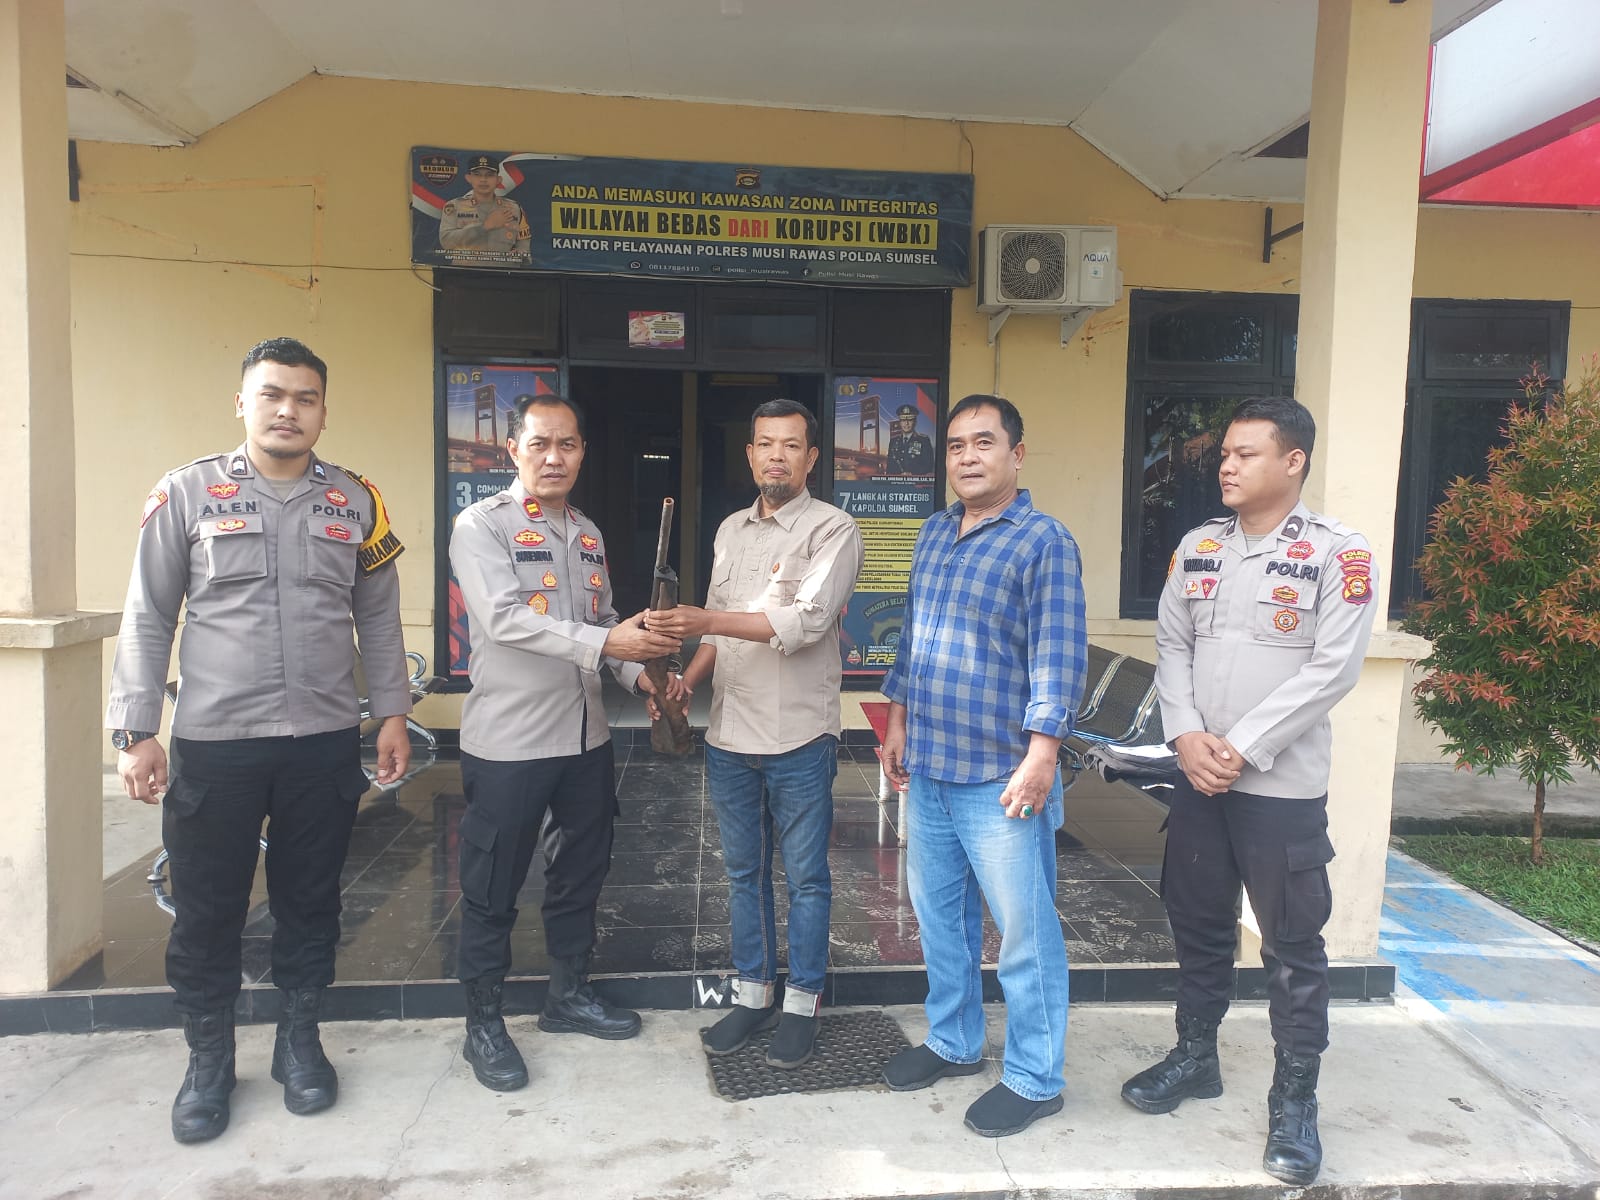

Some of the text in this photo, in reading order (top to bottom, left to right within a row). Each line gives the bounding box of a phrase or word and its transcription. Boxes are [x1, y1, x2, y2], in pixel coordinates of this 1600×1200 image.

[551, 185, 938, 215] ANDA MEMASUKI KAWASAN ZONA INTEGRITAS
[560, 207, 649, 233] WILAYAH
[657, 212, 721, 237] BEBAS
[728, 218, 769, 239] DARI
[775, 217, 861, 242] KORUPSI
[552, 238, 938, 265] KANTOR PELAYANAN POLRES MUSI RAWAS POLDA SUMSEL
[1083, 253, 1109, 262] AQUA
[456, 481, 472, 508] 3
[839, 492, 851, 512] 7
[852, 493, 930, 502] LANGKAH STRATEGIS
[202, 501, 257, 515] ALEN
[312, 504, 361, 521] POLRI
[852, 504, 919, 513] KAPOLDA SUMSEL
[580, 552, 604, 566] POLRI
[1265, 561, 1320, 580] POLRI
